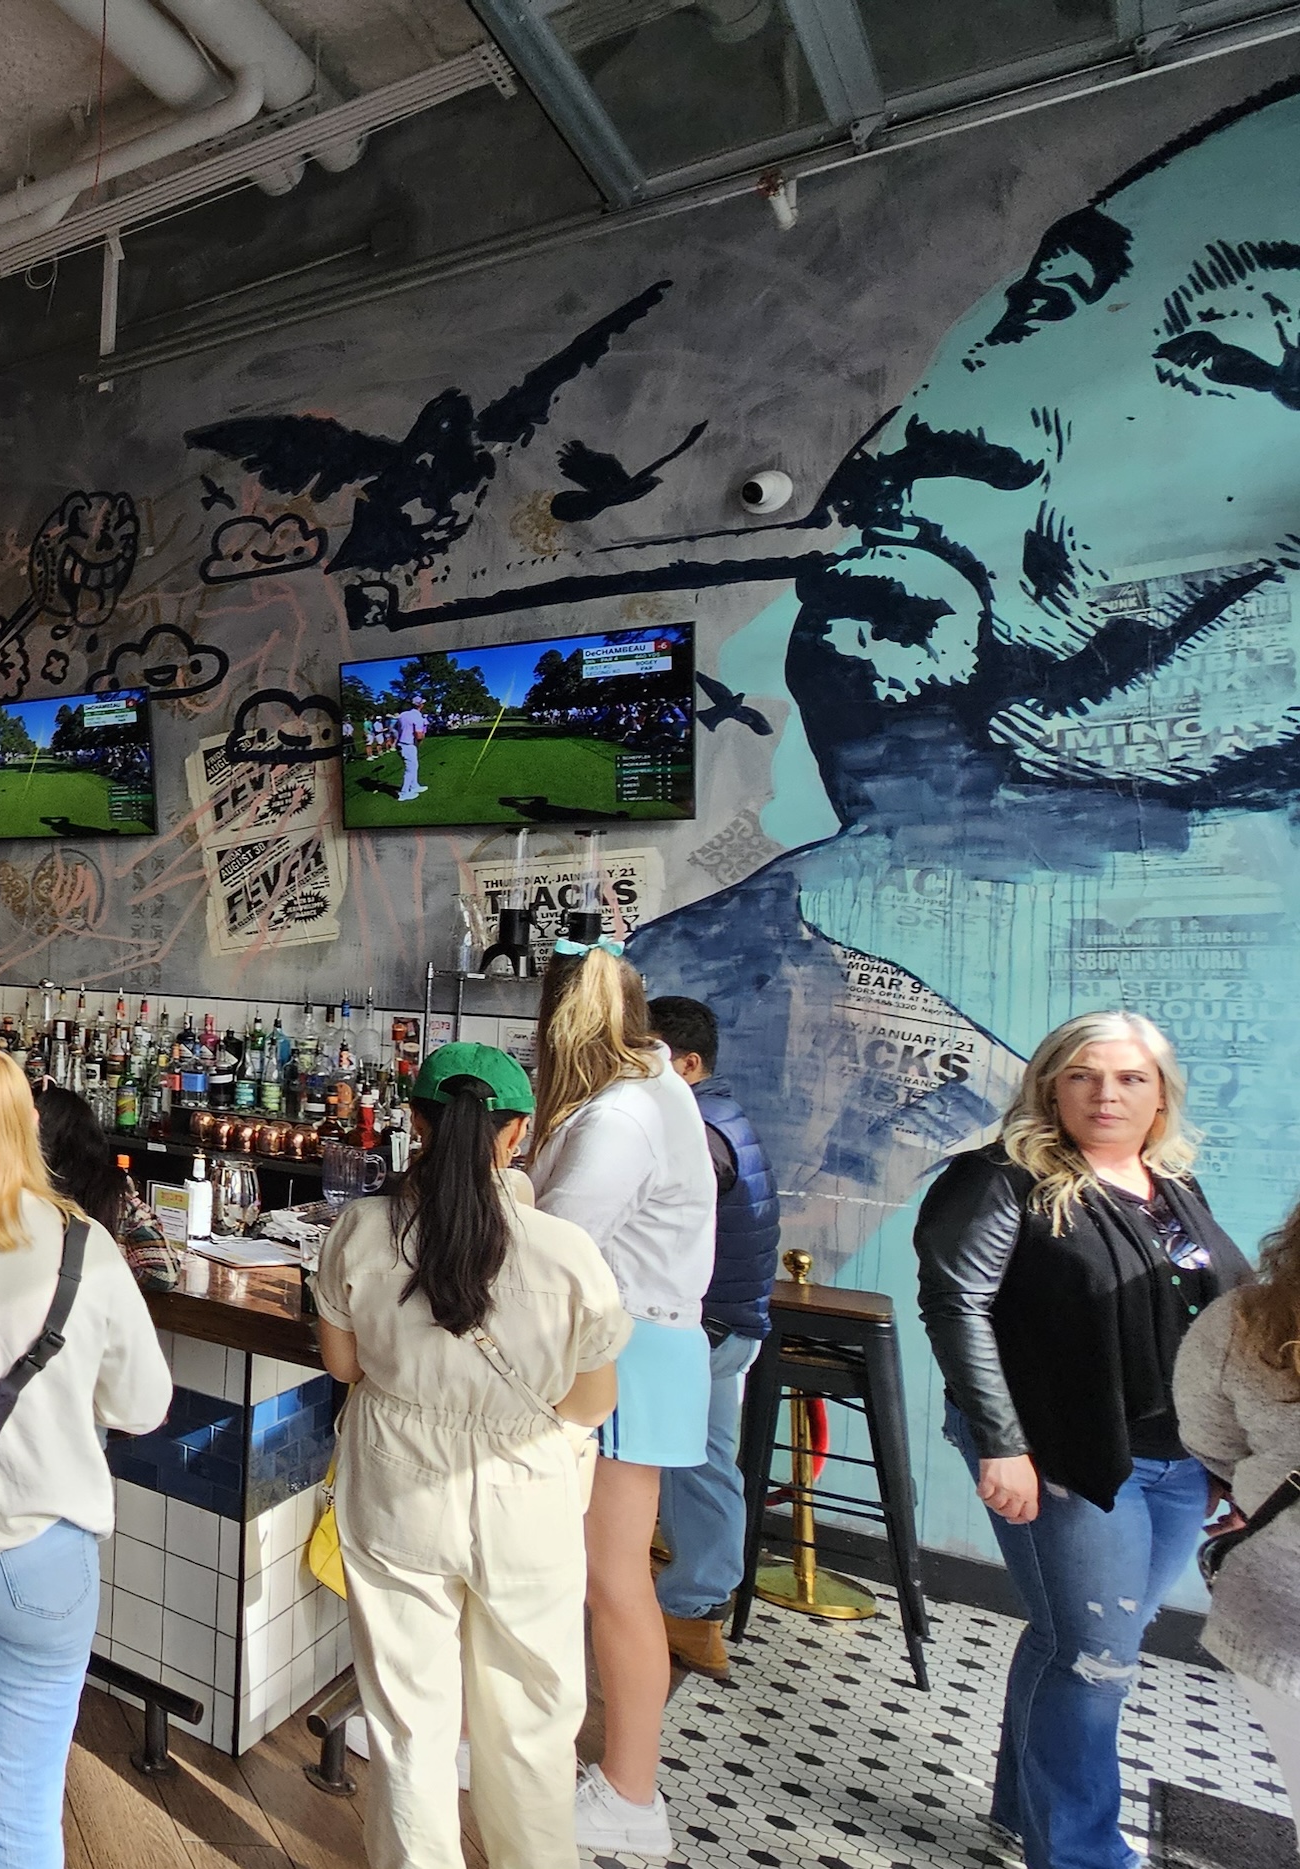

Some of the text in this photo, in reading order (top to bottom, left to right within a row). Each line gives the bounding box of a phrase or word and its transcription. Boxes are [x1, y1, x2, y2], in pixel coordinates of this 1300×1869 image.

[585, 642, 668, 657] DeCHAMBEAU -6
[1172, 648, 1291, 676] UBLE
[1151, 673, 1247, 698] UNK
[205, 748, 227, 767] FRIDA
[220, 843, 266, 879] AUGUST 30
[555, 868, 616, 883] JANY
[620, 868, 637, 877] 21
[484, 879, 638, 915] TACS
[1172, 932, 1268, 944] SPECTACULAR
[1159, 950, 1242, 970] CULTURAL
[857, 973, 903, 990] BAR
[1123, 981, 1211, 998] SEPT.
[1224, 981, 1266, 998] 23
[1125, 1000, 1278, 1020] ROUBL
[868, 1026, 950, 1048] JANUARY
[954, 1041, 975, 1054] 21
